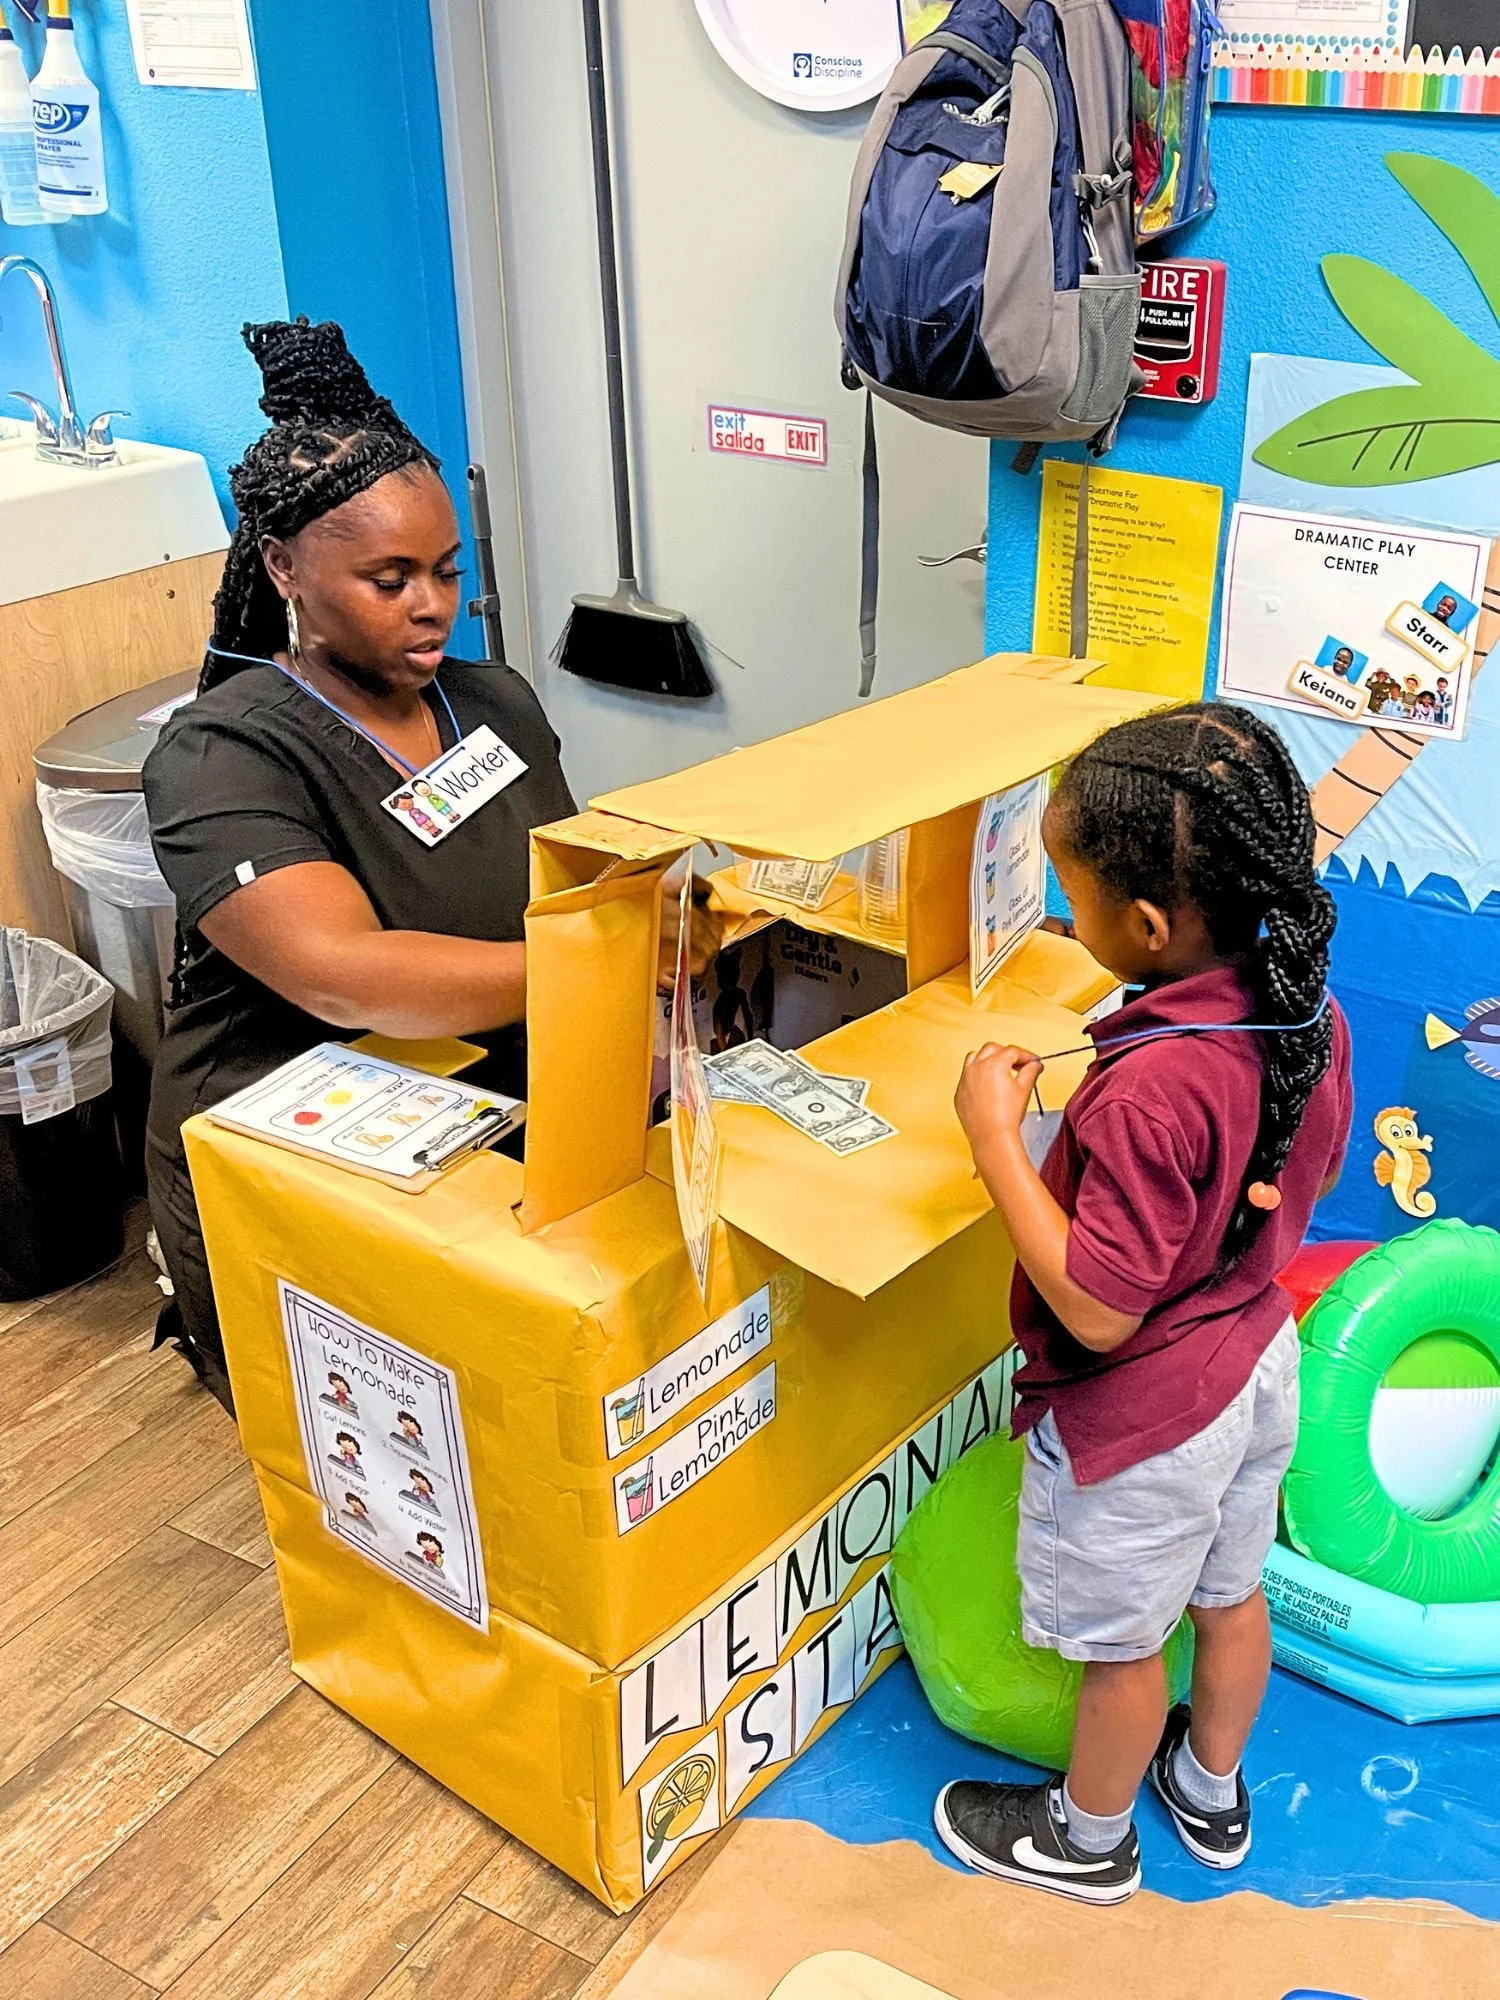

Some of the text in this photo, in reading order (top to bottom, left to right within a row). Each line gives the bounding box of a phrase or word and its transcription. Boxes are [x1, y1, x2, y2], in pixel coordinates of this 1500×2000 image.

[814, 55, 862, 66] Conscious
[814, 66, 862, 79] Discipline
[1145, 316, 1183, 327] PULL DOWN
[1149, 308, 1167, 317] PUSH
[714, 412, 746, 431] exit
[716, 430, 764, 452] salida
[787, 429, 818, 452] EXIT
[1088, 485, 1123, 498] Questions
[1125, 490, 1138, 499] For
[1125, 501, 1139, 513] Play
[1295, 528, 1416, 557] DRAMATIC PLAY
[1324, 555, 1379, 576] CENTER
[1406, 616, 1449, 654] Starr
[1298, 670, 1357, 711] Keiana
[434, 745, 509, 800] Worker
[1008, 832, 1028, 860] Glass of
[1007, 848, 1031, 877] Lemonade
[1008, 884, 1029, 912] Glass of
[1001, 893, 1038, 934] Pink Lemonade
[785, 924, 838, 955] Dry &
[780, 943, 842, 975] Gentle
[794, 966, 829, 983] Diapers
[323, 1344, 416, 1409] Lemonade
[383, 1353, 424, 1389] Make
[650, 1312, 769, 1414] Lemonade
[698, 1396, 745, 1449] Pink
[659, 1398, 774, 1501] Lemonade
[644, 1344, 1027, 1744] LEMONA
[1268, 1571, 1282, 1585] DES
[1281, 1577, 1312, 1600] PISCINES
[1312, 1591, 1352, 1619] PORTABLES.
[1282, 1592, 1293, 1605] NE
[1292, 1597, 1320, 1618] LAISSEZ
[1320, 1609, 1335, 1624] PAS
[1334, 1615, 1349, 1630] LES
